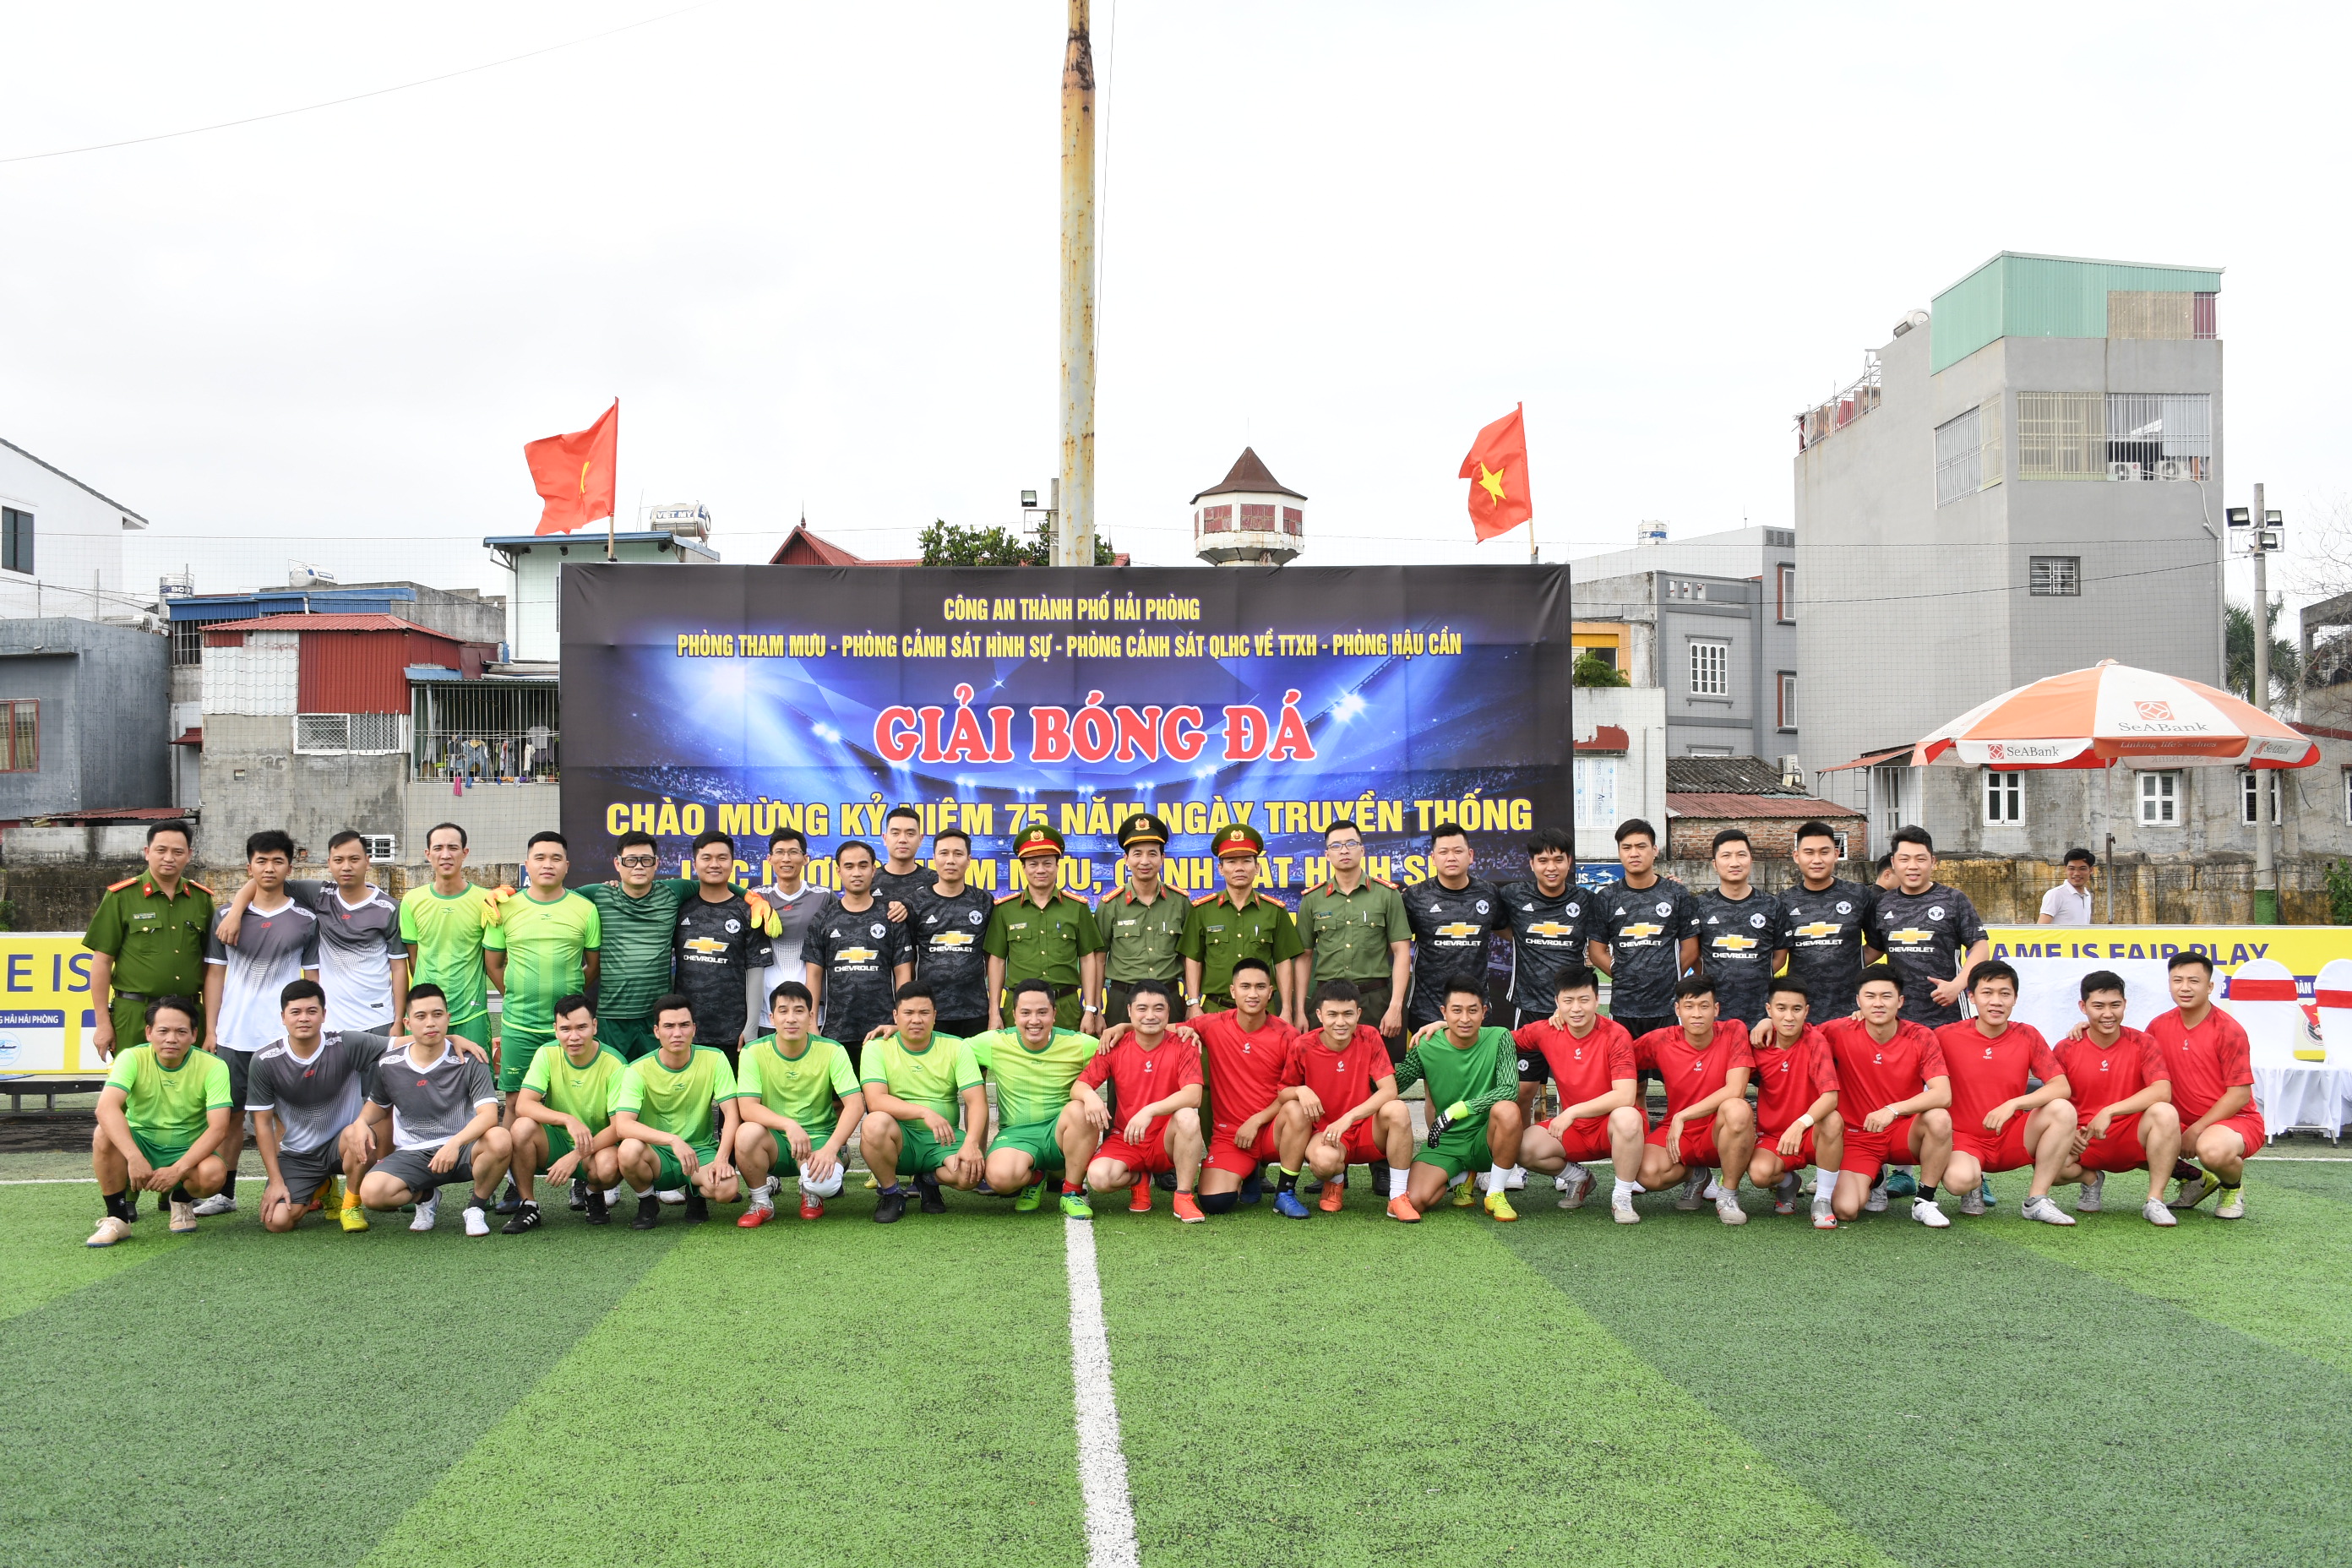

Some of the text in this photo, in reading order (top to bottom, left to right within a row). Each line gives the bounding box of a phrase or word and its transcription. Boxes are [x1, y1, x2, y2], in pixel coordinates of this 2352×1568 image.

[944, 591, 1200, 621] CÔNG AN THÀNH PHỐ HẢI PHÒNG
[678, 629, 733, 656] PHÒNG
[738, 634, 784, 656] THAM
[789, 633, 826, 657] MƯU
[842, 630, 897, 657] PHÒNG
[901, 628, 946, 657] CẢNH
[950, 631, 982, 658] SÁT
[986, 631, 1025, 657] HÌNH
[1029, 634, 1054, 662] SỰ
[1067, 630, 1122, 658] PHÒNG
[1126, 629, 1170, 658] CẢNH
[1174, 631, 1206, 657] SÁT
[1209, 634, 1250, 659] QLHC
[1254, 629, 1274, 656] VỀ
[1278, 634, 1317, 656] TTXH
[1332, 629, 1387, 656] PHÒNG
[1391, 629, 1424, 660] HẬU
[1429, 626, 1462, 655] CẦN
[873, 683, 1318, 763] GIẢI BÓNG ĐÁ
[2119, 722, 2209, 732] SeABank
[2121, 741, 2156, 749] Linking
[2006, 746, 2059, 757] SeABank
[607, 797, 705, 836] CHÀO
[718, 797, 828, 836] MỪNG
[841, 792, 889, 838] KỶ
[1004, 803, 1048, 837] 75
[1157, 795, 1254, 837] NGÀY
[1264, 790, 1403, 836] TRUYỀN
[1413, 787, 1533, 831] THỐNG
[681, 858, 749, 890] LC
[1115, 858, 1213, 890] CNH
[1252, 850, 1293, 889] ÁT
[1305, 855, 1391, 888] HH
[1525, 938, 1574, 947] CHEVROLET
[1619, 939, 1663, 948] CHEVROLET
[1795, 939, 1843, 947] CHEVROLET
[928, 945, 973, 953] CHEVROLET
[683, 953, 728, 964] CHEVROLET
[1965, 944, 2061, 959] AME
[2072, 944, 2099, 959] IS
[2188, 944, 2269, 966] PLAY
[52, 953, 94, 993] IS
[4, 1014, 18, 1024] HẢI
[19, 1014, 31, 1024] HẢI
[32, 1014, 59, 1024] PHÒNG
